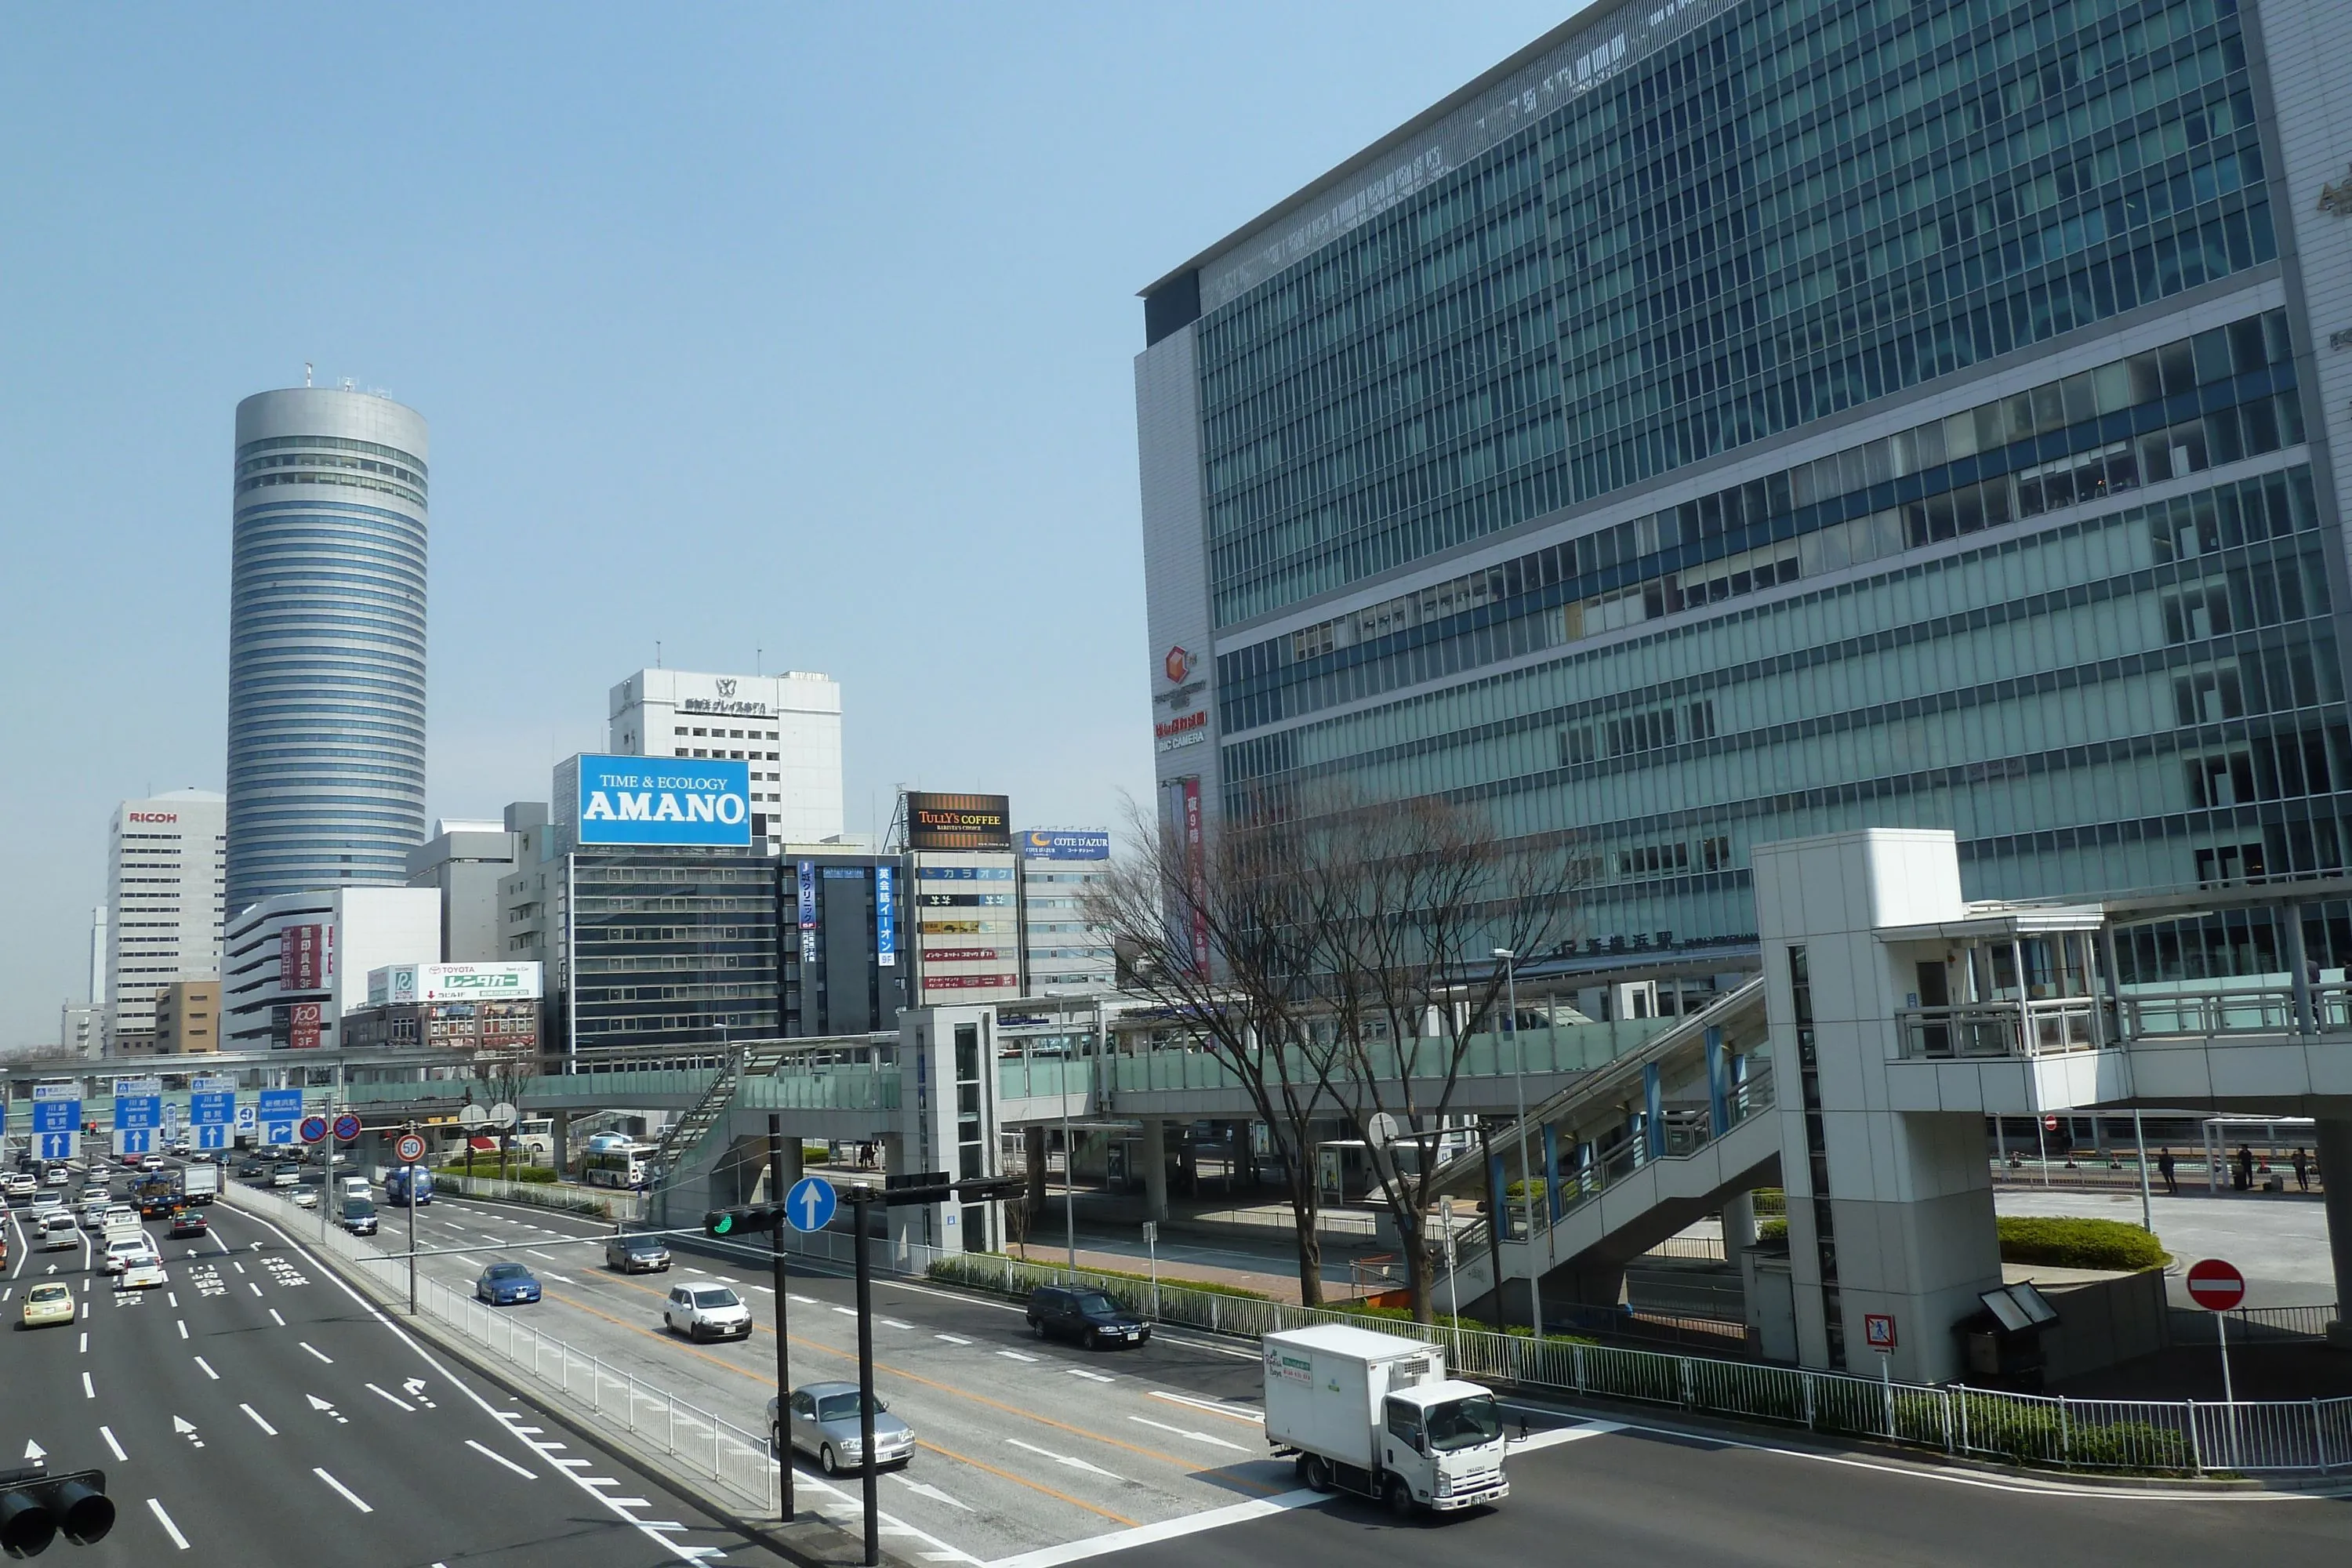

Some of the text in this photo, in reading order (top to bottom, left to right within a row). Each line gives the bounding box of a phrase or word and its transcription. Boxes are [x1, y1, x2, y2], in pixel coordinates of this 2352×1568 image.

[1159, 731, 1204, 753] BIC CAMERA
[600, 775, 728, 791] TIME & ECOLOGY
[583, 791, 745, 824] AMANO
[129, 812, 177, 823] RICOH
[961, 815, 1001, 825] COFFEE
[1078, 837, 1109, 847] D'AZUR
[944, 869, 1007, 878] カラオケ
[879, 868, 891, 952] 英会話イーオン
[300, 927, 311, 976] 無印良品
[881, 955, 891, 964] 9F
[299, 978, 312, 989] 3F
[448, 975, 517, 988] レンタカー
[298, 1037, 313, 1046] 3F
[403, 1142, 418, 1153] 50
